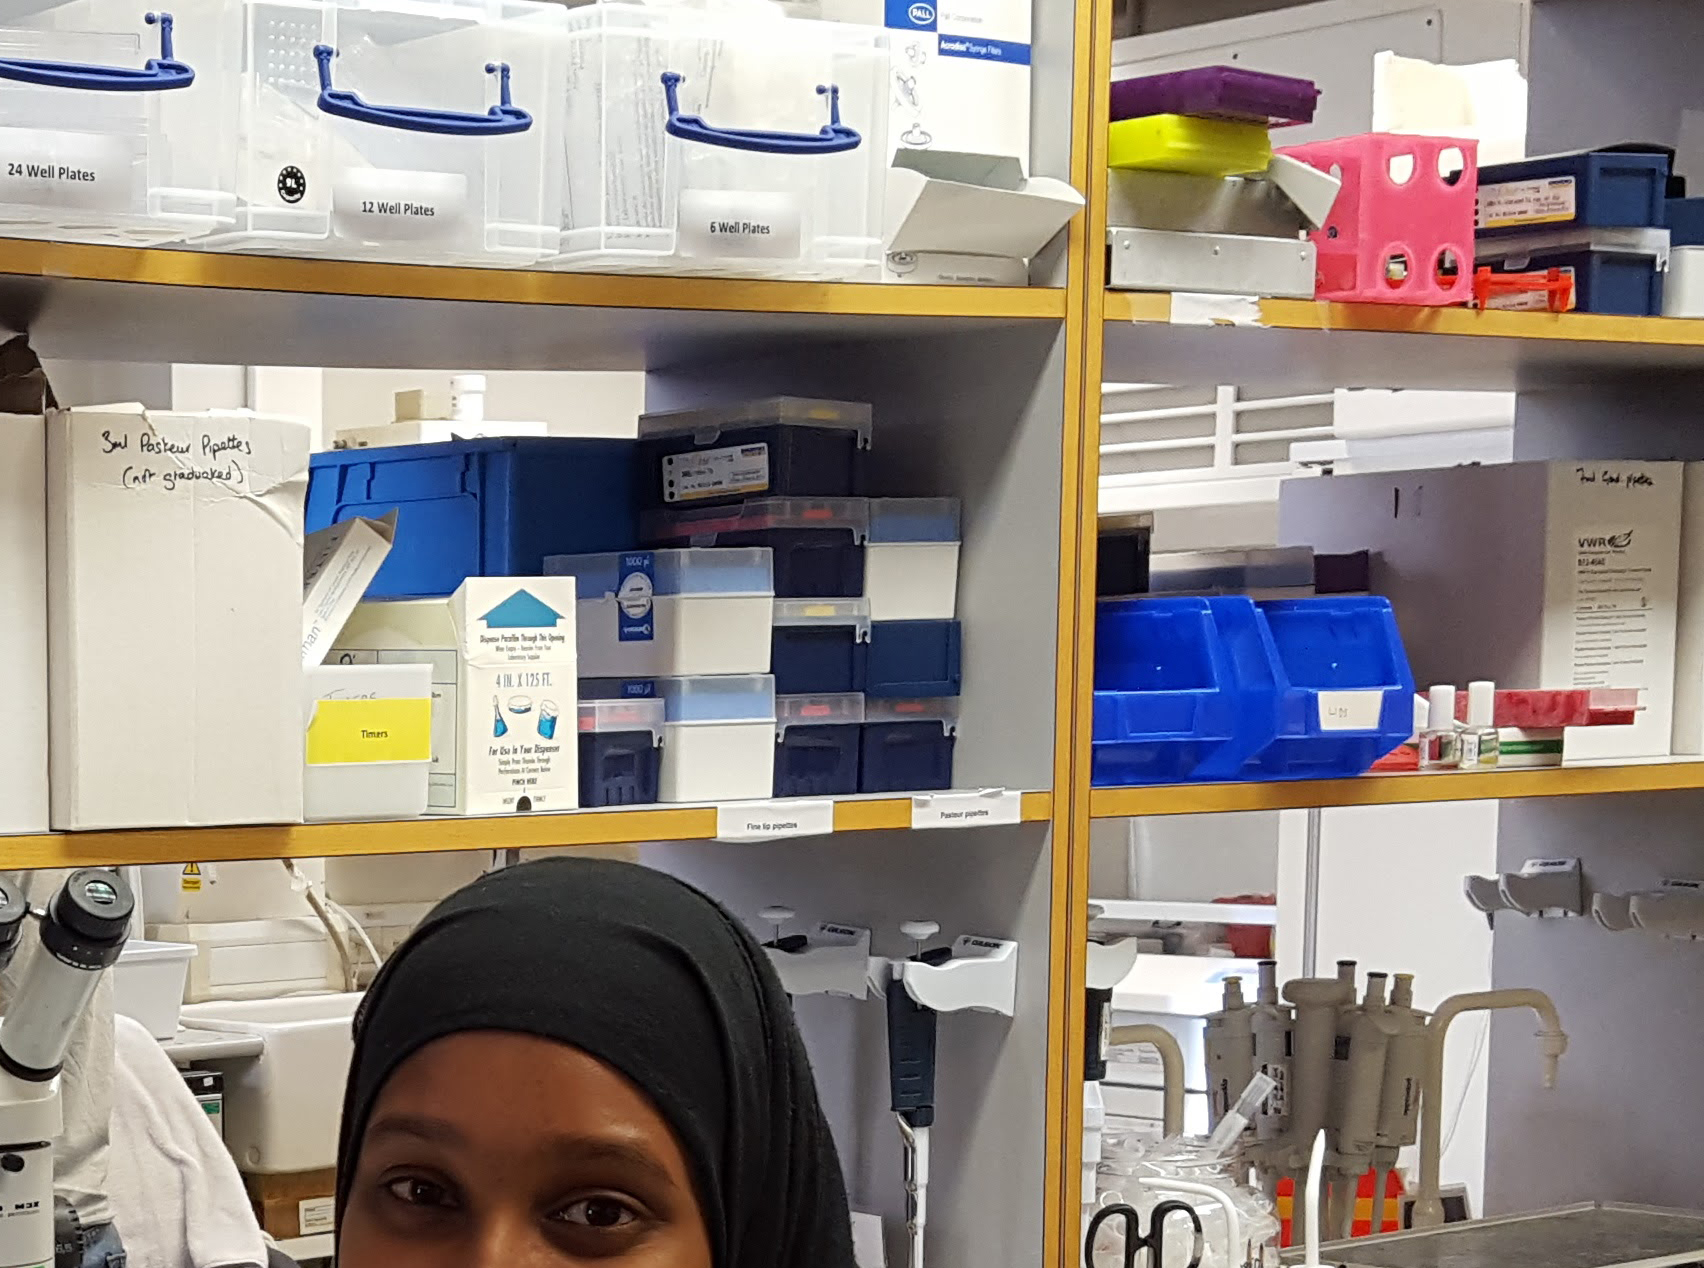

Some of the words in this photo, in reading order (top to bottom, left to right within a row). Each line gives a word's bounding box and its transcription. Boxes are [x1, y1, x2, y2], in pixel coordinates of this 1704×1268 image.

[912, 8, 932, 19] PALL
[8, 163, 23, 176] 24
[26, 164, 55, 179] Well
[58, 166, 96, 182] Plates
[362, 201, 374, 213] 12
[377, 201, 401, 215] Well
[404, 203, 435, 217] Plates
[719, 222, 740, 233] Well
[742, 222, 770, 234] Plates
[140, 433, 191, 454] Pasteur
[201, 434, 252, 461] Pipettes
[123, 466, 156, 489] (not
[163, 459, 244, 491] graduated)
[1578, 537, 1607, 548] VWR
[525, 672, 540, 687] 125
[361, 729, 388, 739] Timers
[940, 810, 963, 820] Pasteur
[964, 809, 989, 820] pipettes
[747, 823, 760, 831] Fine
[772, 822, 797, 831] pipettes
